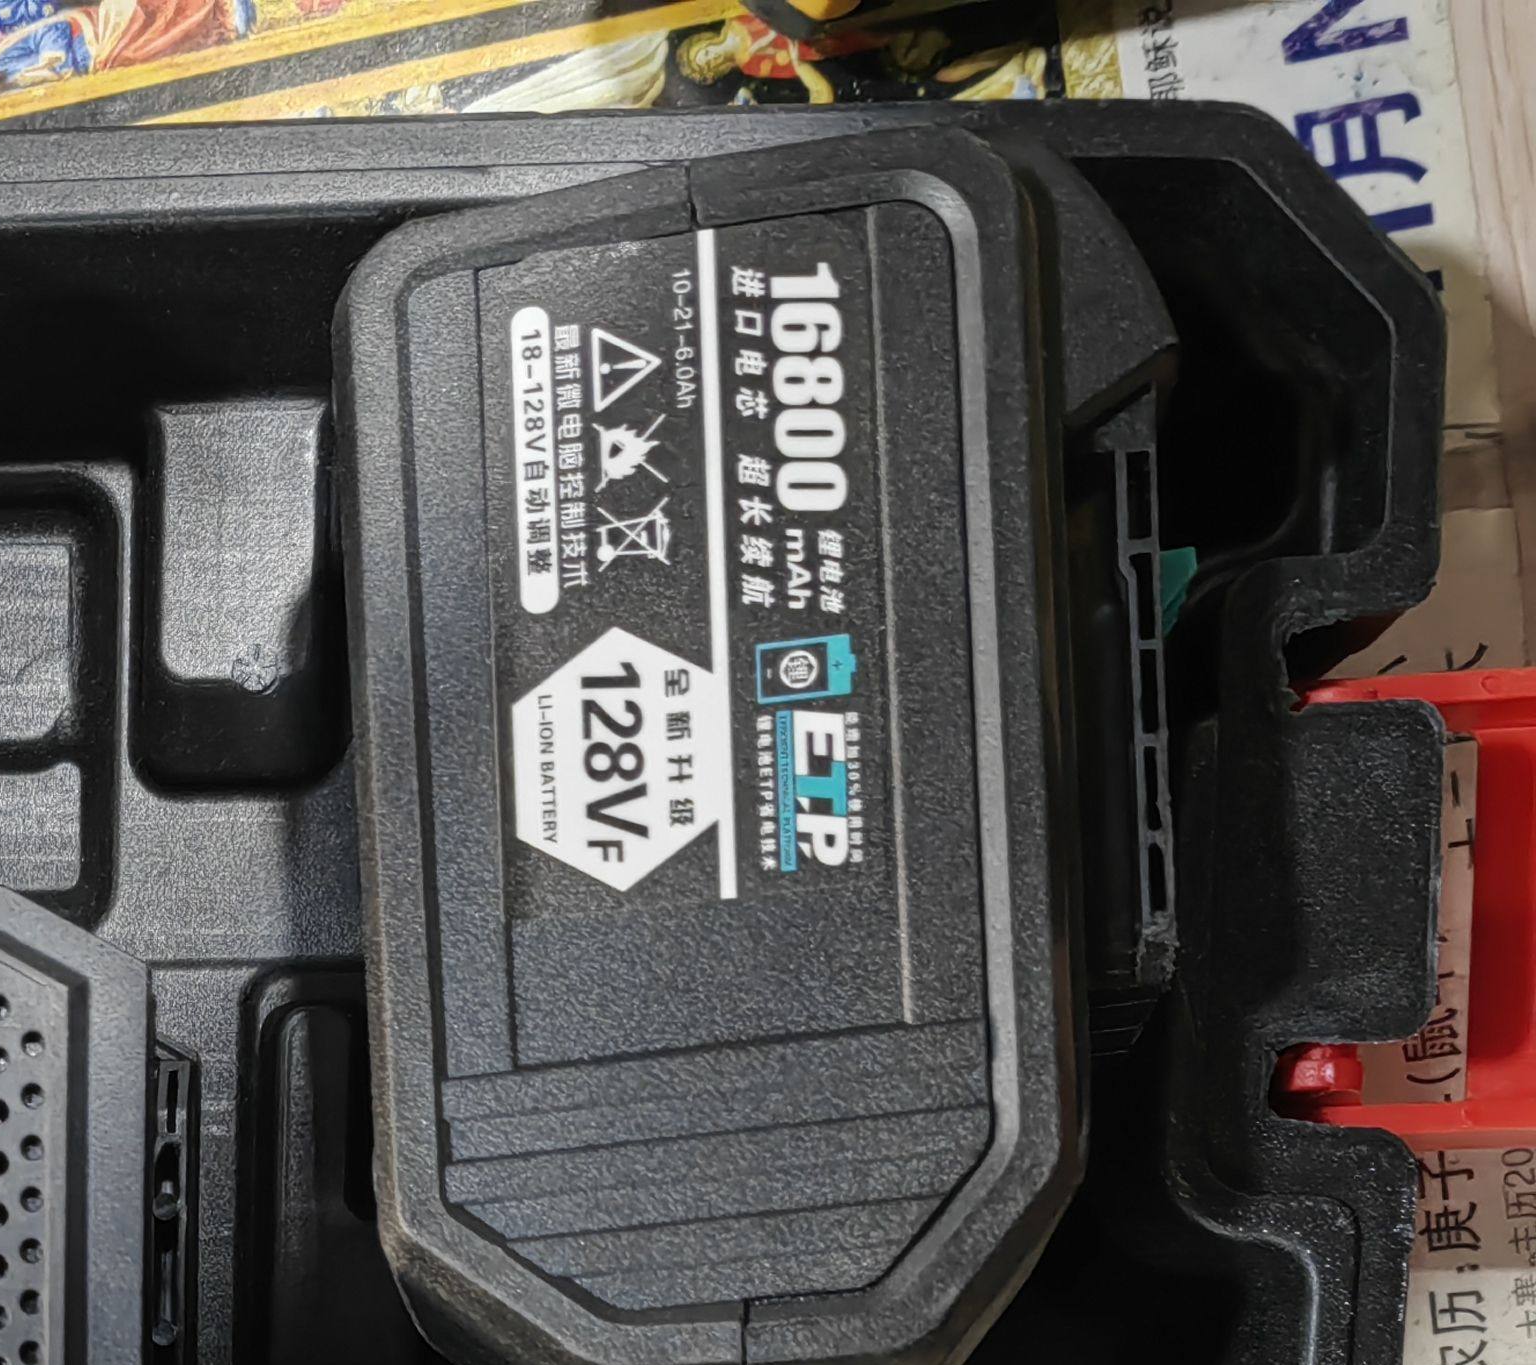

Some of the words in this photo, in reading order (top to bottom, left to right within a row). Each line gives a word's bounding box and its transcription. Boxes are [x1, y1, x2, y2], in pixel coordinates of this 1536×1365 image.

[731, 266, 769, 419] 进口电芯
[770, 263, 847, 510] 16800
[556, 324, 588, 587] 最新微电脑控制技术
[736, 454, 773, 608] 超长续航
[785, 529, 810, 610] mAh
[817, 529, 843, 613] 锂电池
[538, 695, 555, 755] LI-ION
[540, 760, 558, 843] BATTERY
[665, 669, 694, 828] 全新升级
[794, 711, 847, 866] ETP
